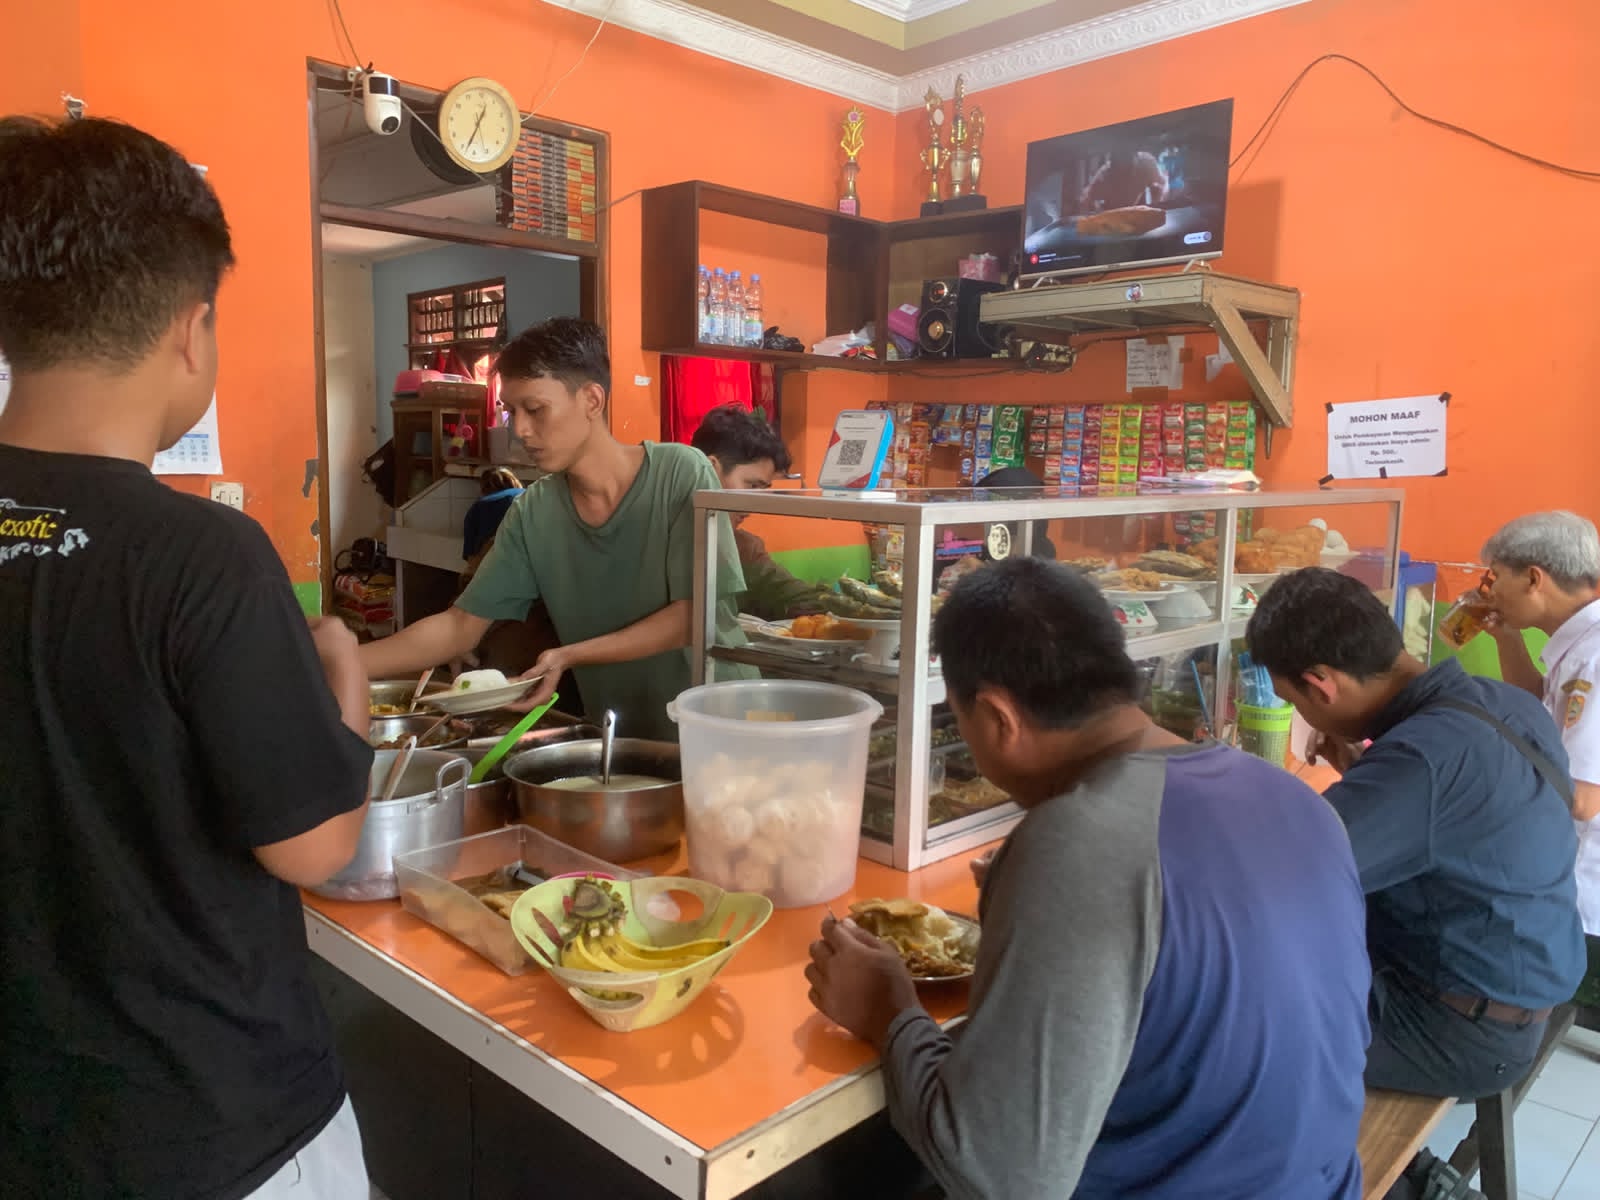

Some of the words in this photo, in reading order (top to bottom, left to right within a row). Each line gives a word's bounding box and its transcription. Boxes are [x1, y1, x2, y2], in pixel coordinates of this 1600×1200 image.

[1350, 413, 1387, 423] MOHON
[1391, 411, 1421, 420] MAAF
[0, 513, 57, 539] exotic
